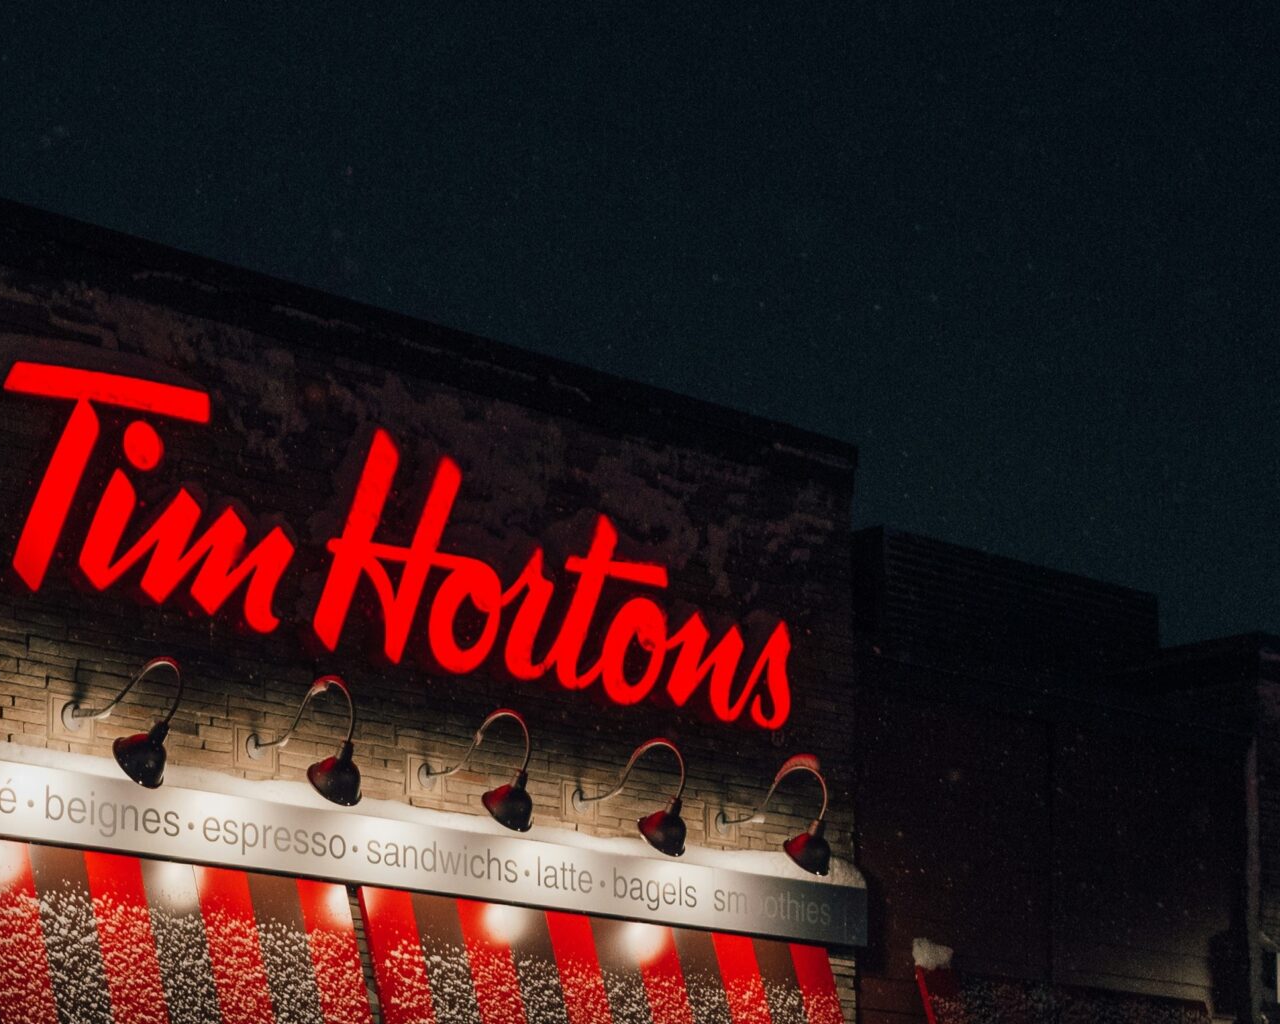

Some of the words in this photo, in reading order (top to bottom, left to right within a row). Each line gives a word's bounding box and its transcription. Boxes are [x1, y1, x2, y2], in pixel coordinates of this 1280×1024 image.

[3, 360, 296, 634] Tim
[313, 427, 791, 730] Hortons
[44, 784, 180, 838] beignes
[202, 815, 347, 860] espresso
[366, 838, 518, 884] sandwichs
[536, 855, 593, 895] latte
[612, 866, 697, 911] bagels
